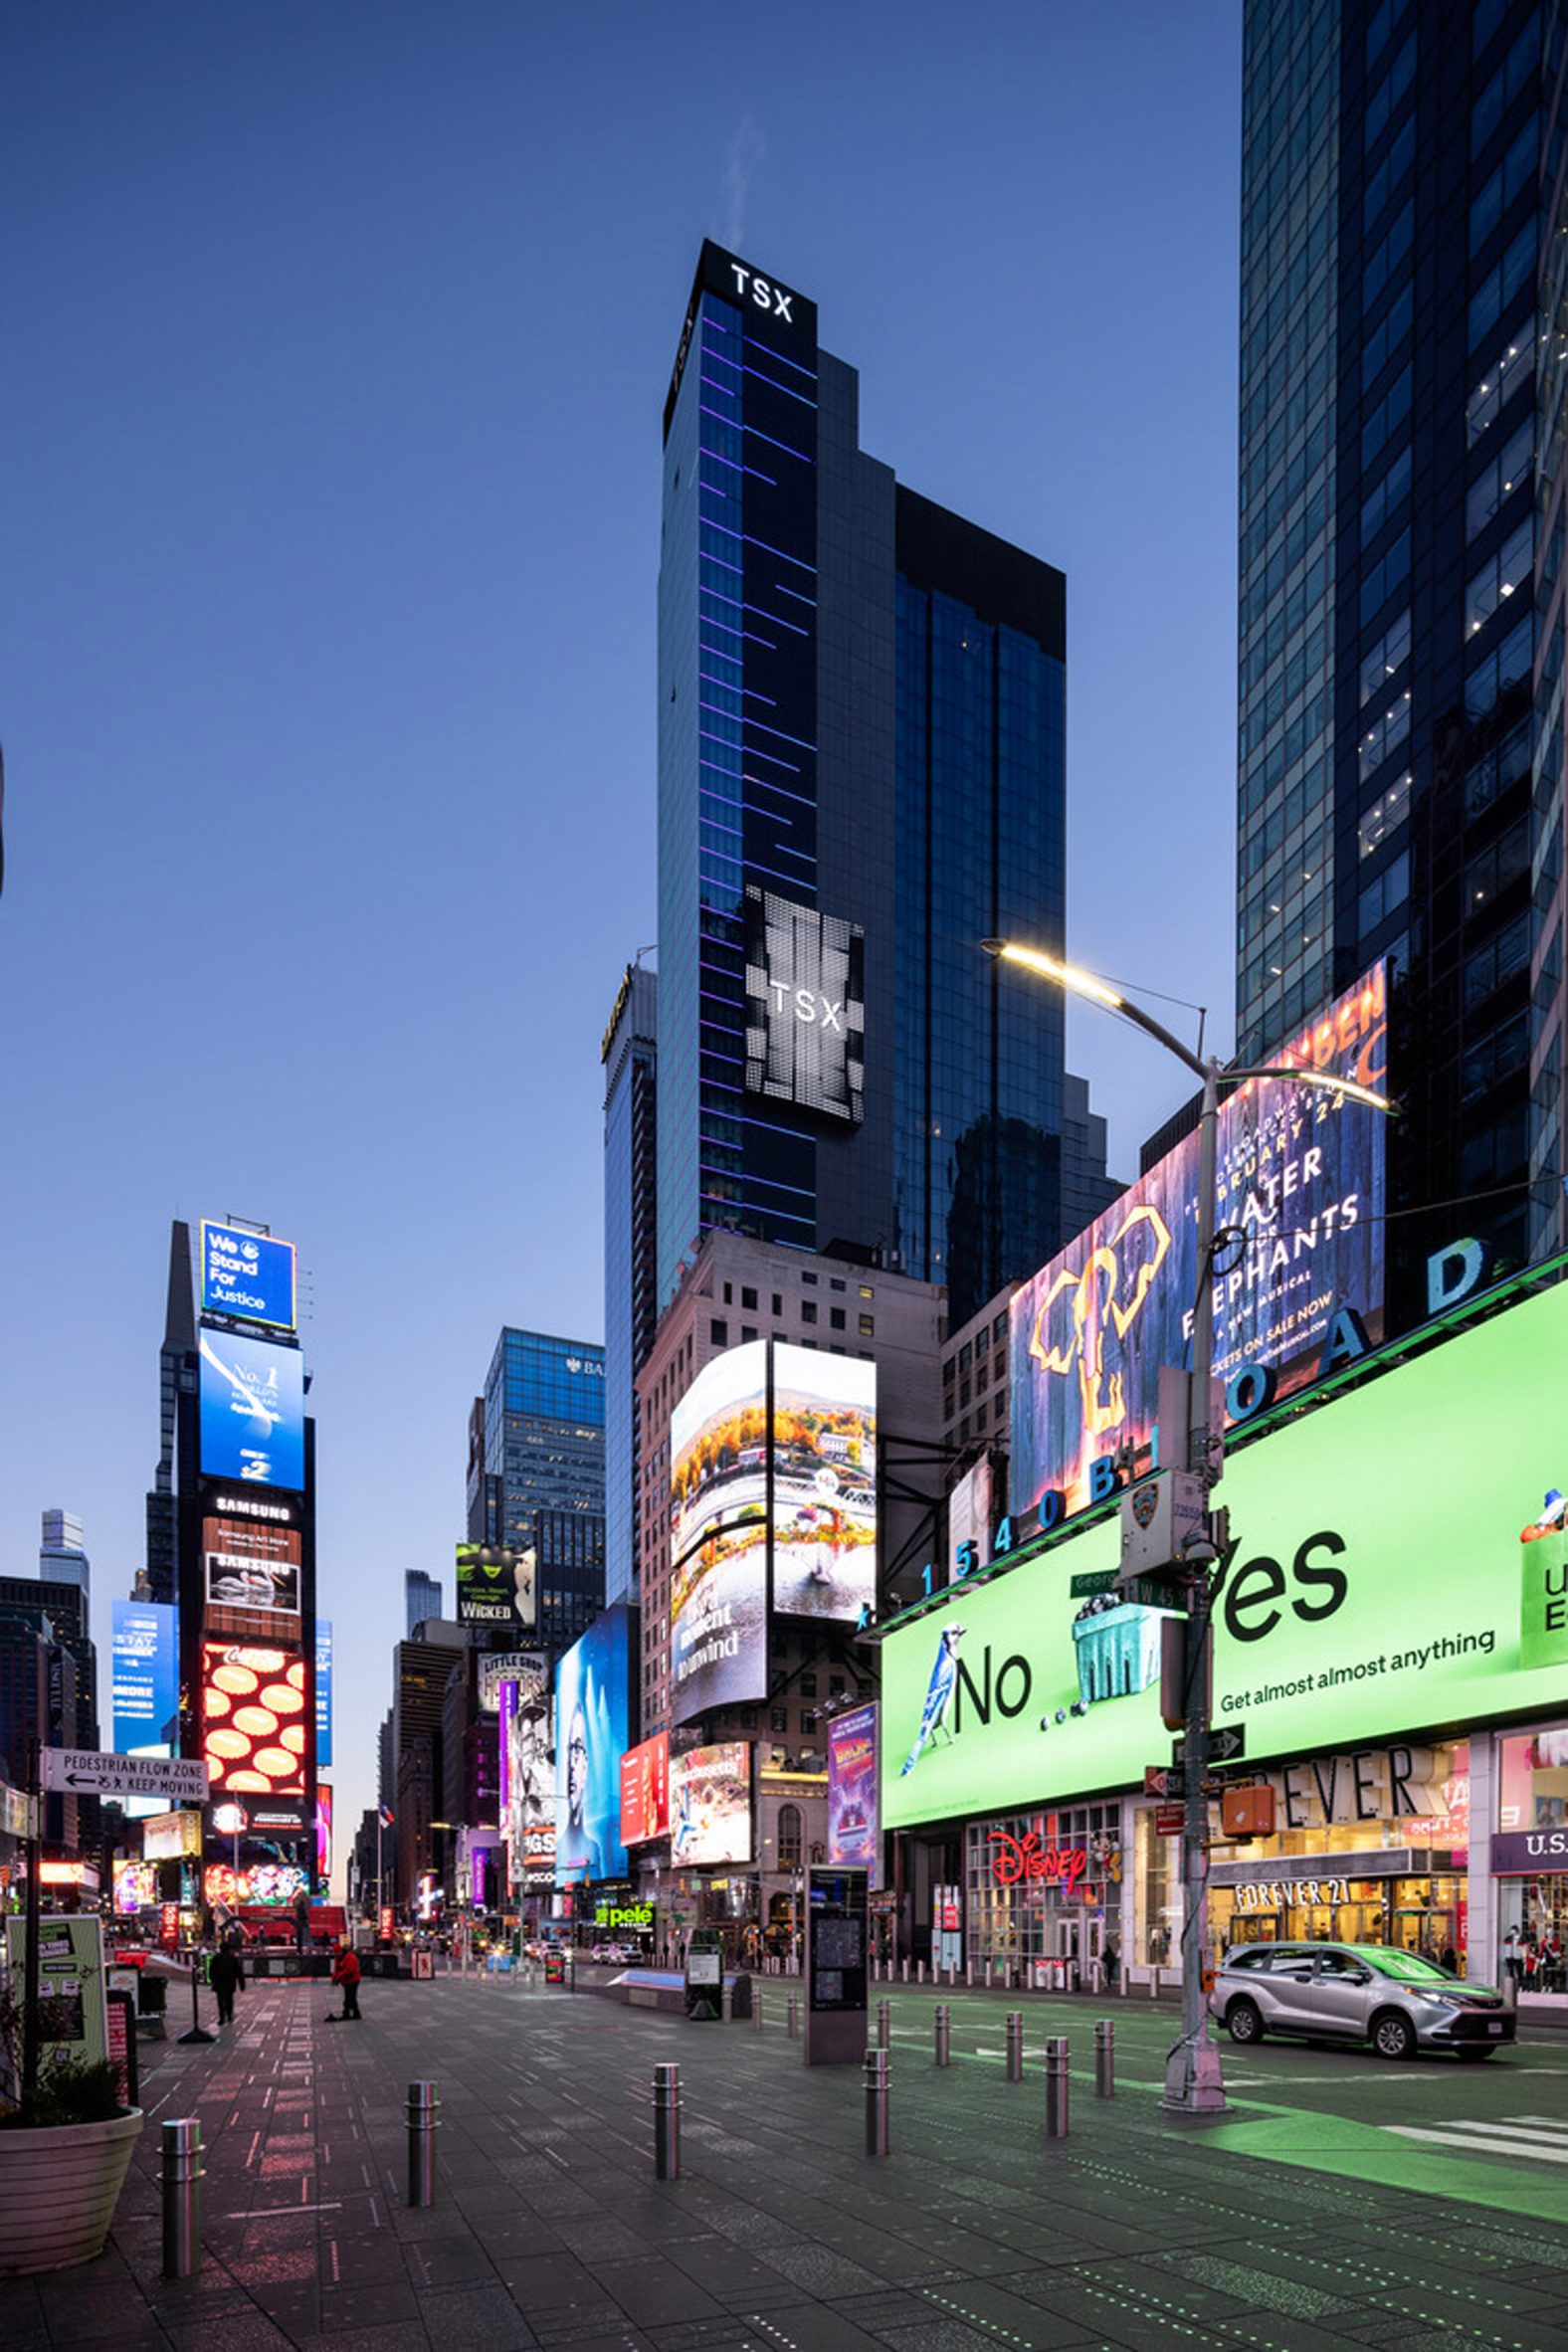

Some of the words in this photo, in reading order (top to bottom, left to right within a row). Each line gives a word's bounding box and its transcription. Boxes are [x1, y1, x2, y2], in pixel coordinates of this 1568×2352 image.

[731, 263, 793, 322] TSX
[769, 979, 841, 1032] TSX
[1184, 1107, 1296, 1216] PEORMANCES
[1306, 1066, 1357, 1111] BEGN
[1195, 1117, 1303, 1225] BRUARY
[1316, 1089, 1345, 1124] 24
[208, 1233, 239, 1254] We
[209, 1251, 259, 1276] Stand
[209, 1268, 237, 1286] For
[1182, 1194, 1358, 1341] EEPHANTS
[209, 1285, 267, 1310] Justice
[1258, 1270, 1312, 1308] MUSICAL
[1210, 1348, 1243, 1378] CKETS
[1244, 1335, 1265, 1355] ON
[1266, 1314, 1296, 1343] SALE
[1296, 1290, 1333, 1321] NOW
[216, 1496, 291, 1521] SAMSUNG
[1075, 1572, 1116, 1590] Georg
[485, 1655, 517, 1673] LITTLE
[519, 1655, 543, 1673] SHOP
[1221, 1691, 1251, 1713] Get
[1254, 1673, 1313, 1706] almost
[1317, 1654, 1387, 1690] almost
[1390, 1629, 1495, 1670] anything
[955, 1645, 1032, 1734] No
[64, 1755, 137, 1774] PEDESTRIAN
[140, 1762, 170, 1777] FLOW
[173, 1764, 202, 1779] ZONE
[127, 1777, 156, 1791] KEEP
[160, 1780, 203, 1795] MOVING
[987, 1831, 1086, 1895] Disney
[1235, 1878, 1325, 1909] FOREVER
[1328, 1877, 1351, 1904] 21
